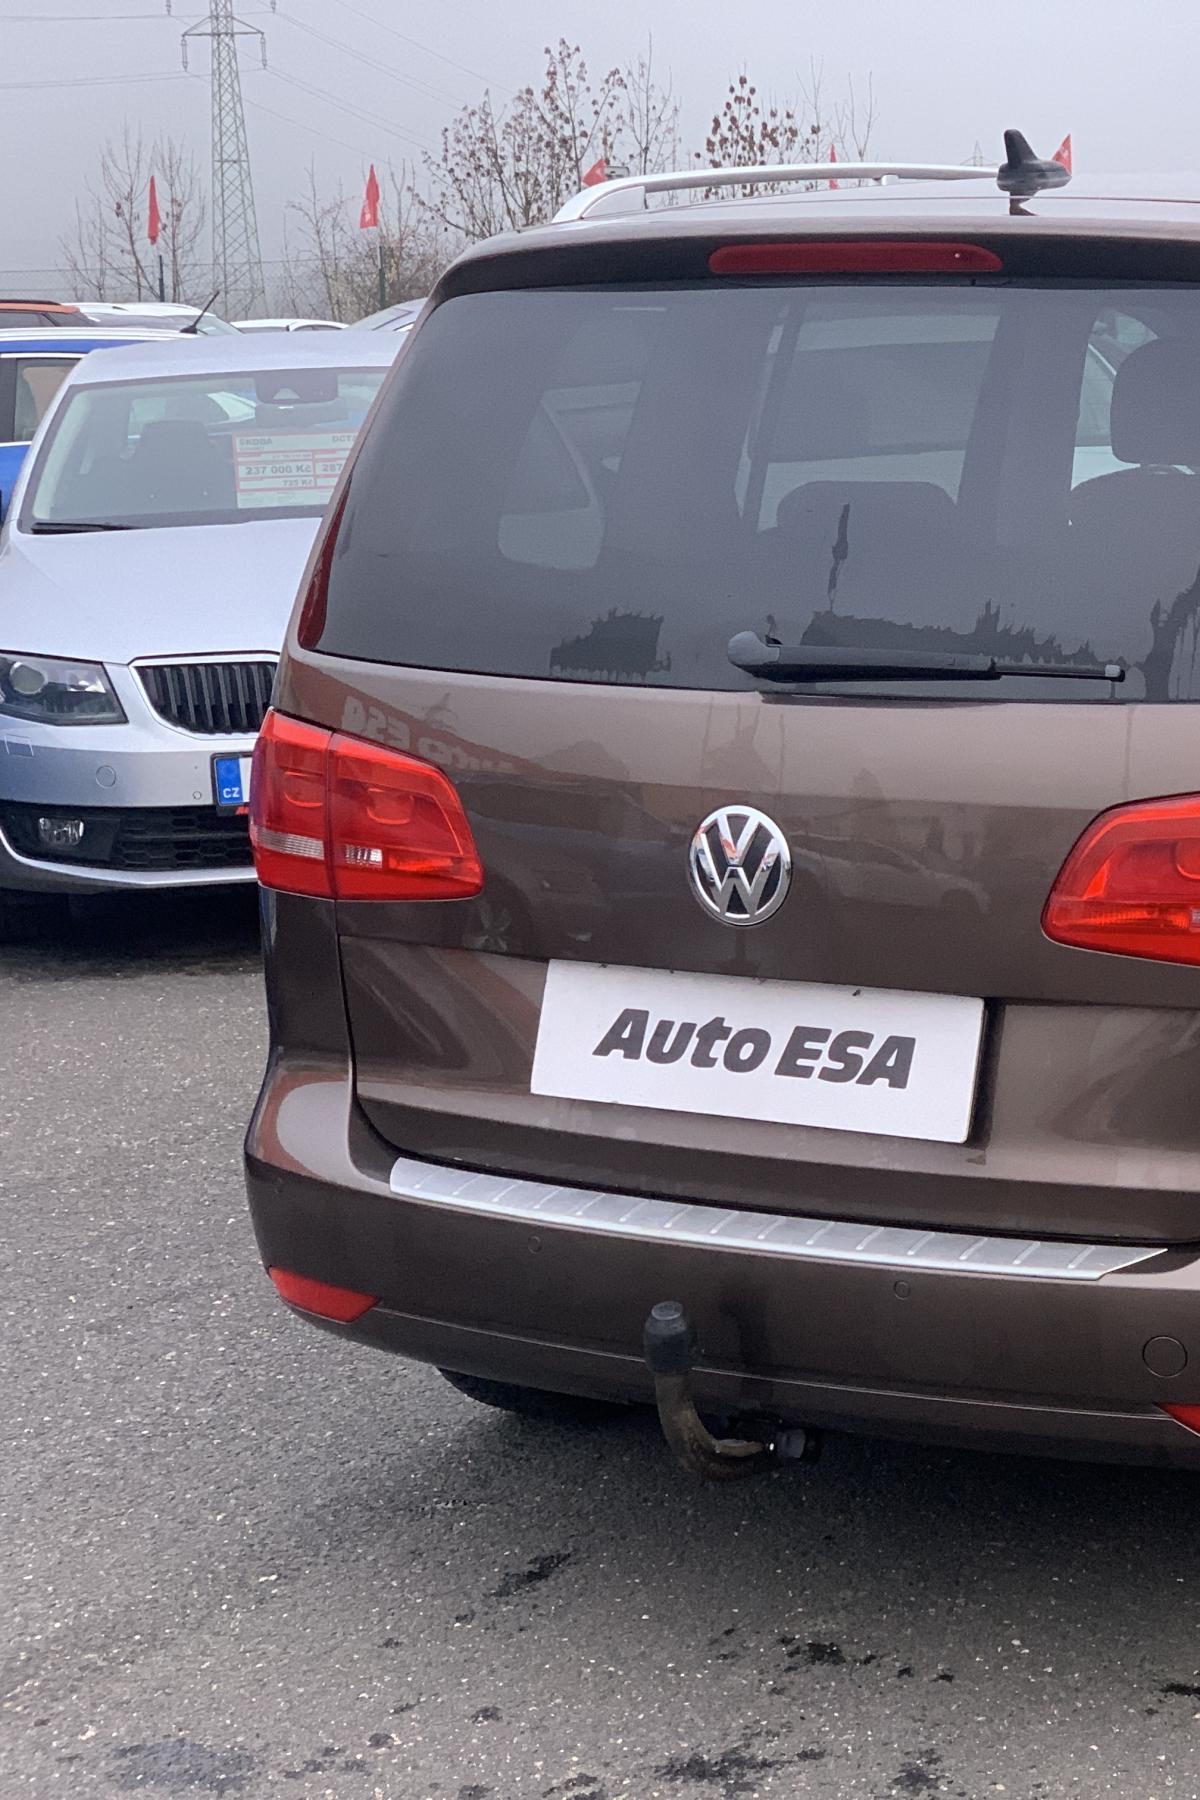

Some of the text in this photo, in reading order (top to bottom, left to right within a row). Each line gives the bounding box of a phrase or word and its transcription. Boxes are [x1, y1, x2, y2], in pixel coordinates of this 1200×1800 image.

[271, 465, 293, 474] 000
[222, 786, 241, 799] CZ
[592, 1008, 916, 1090] Auto ESA
